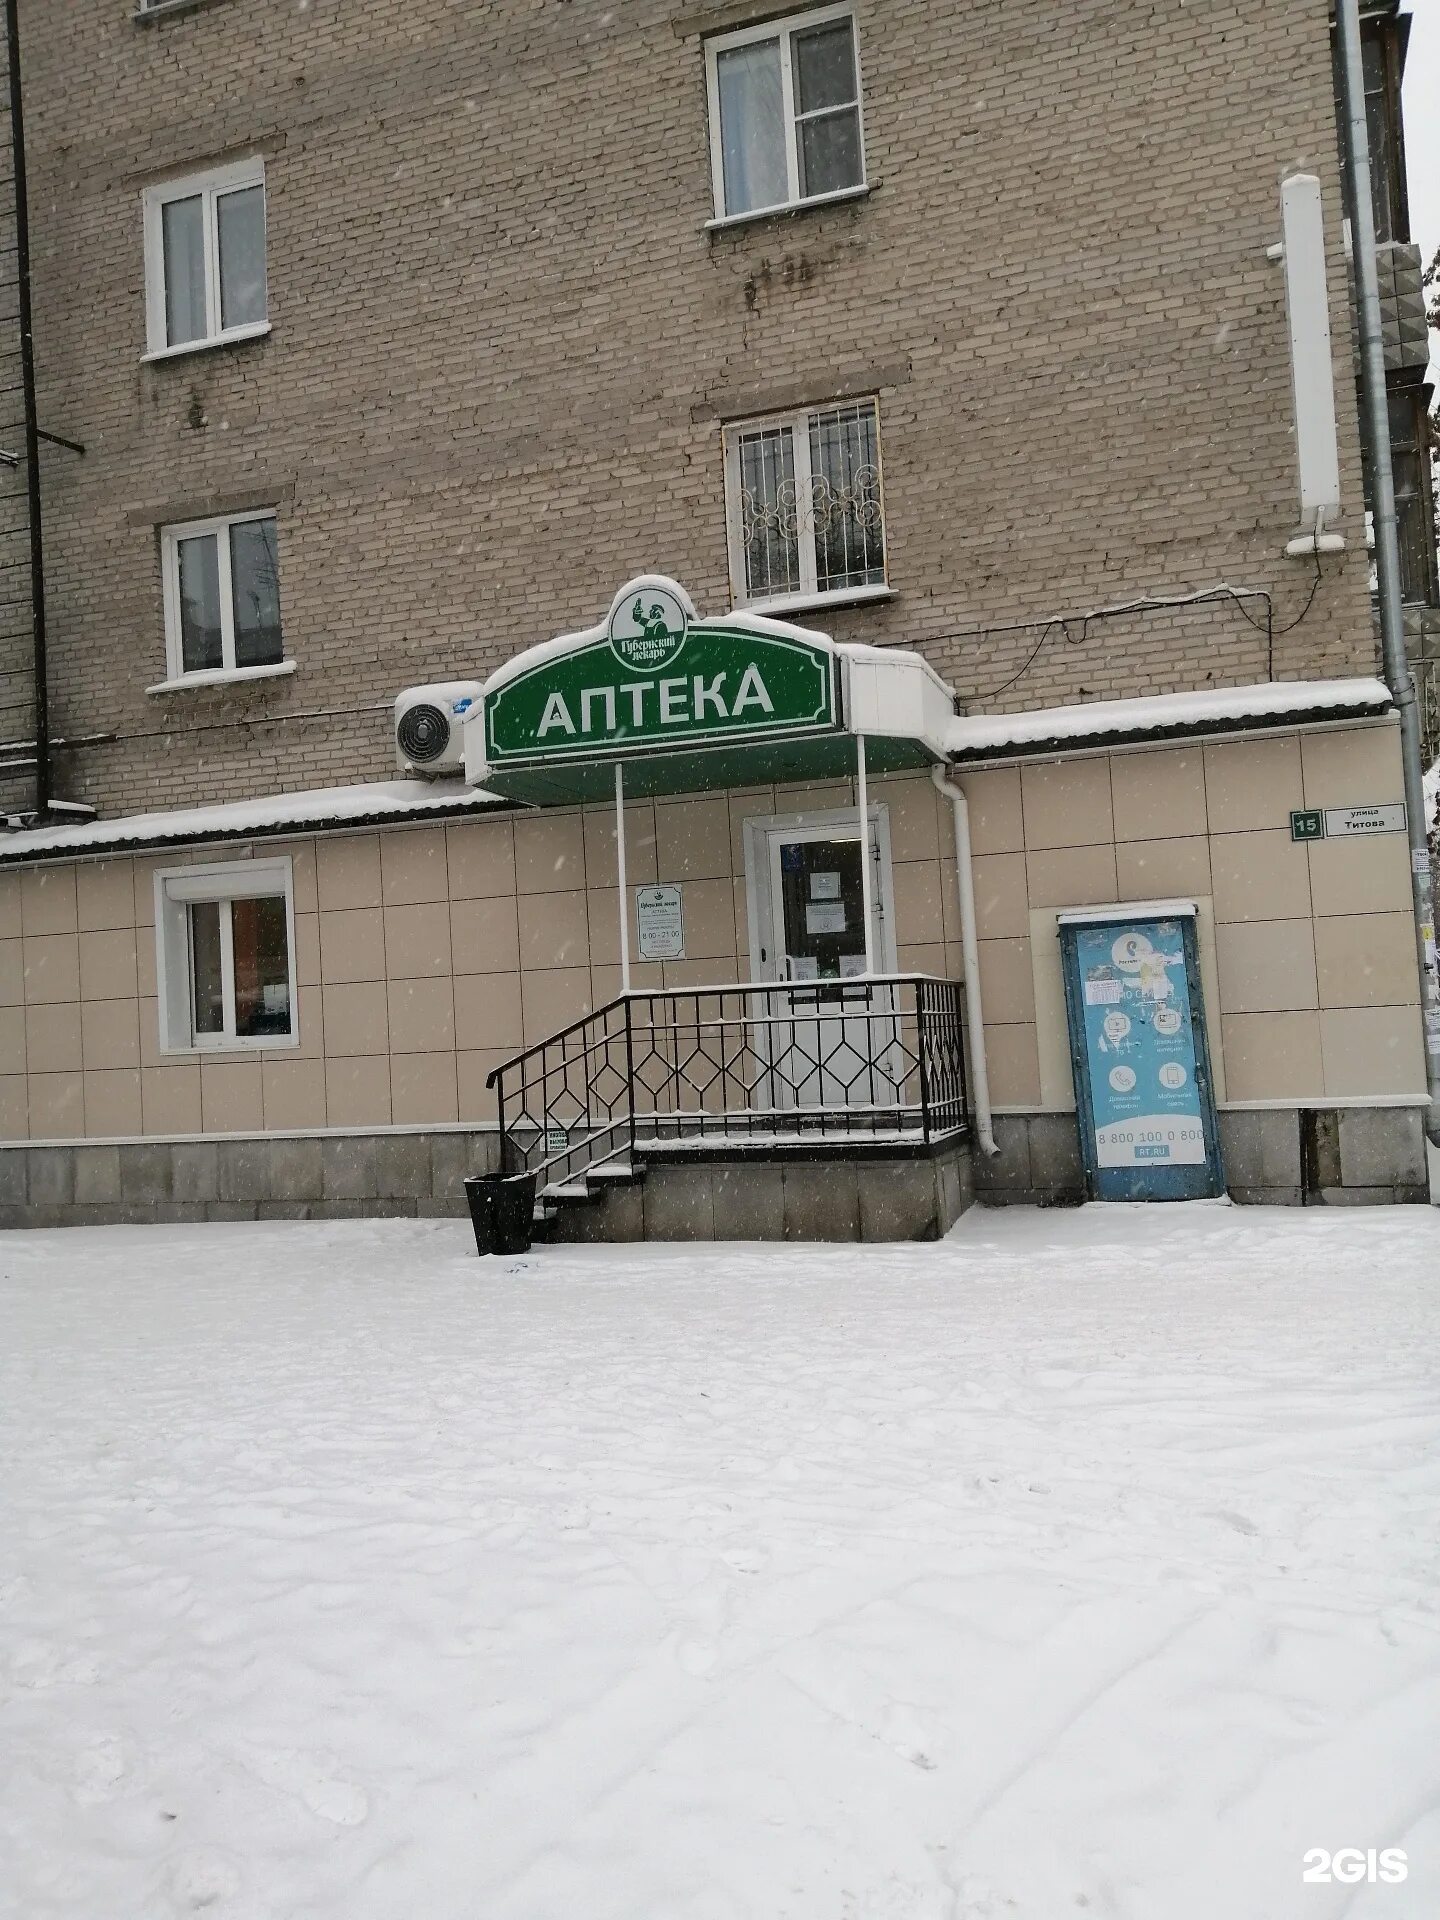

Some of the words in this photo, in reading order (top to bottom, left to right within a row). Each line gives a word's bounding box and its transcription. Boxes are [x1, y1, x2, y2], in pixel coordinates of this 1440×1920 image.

[621, 635, 676, 654] Губернский
[632, 648, 666, 661] лекарь
[536, 661, 775, 738] АПТЕКА
[1350, 809, 1379, 818] улица
[1295, 819, 1317, 832] 15
[1344, 819, 1385, 829] Титова
[1099, 1134, 1106, 1145] 8
[1111, 1133, 1134, 1144] 800
[1139, 1132, 1162, 1142] 100
[1167, 1131, 1175, 1141] 0
[1181, 1129, 1204, 1141] 800
[1139, 1147, 1165, 1156] RT.RU
